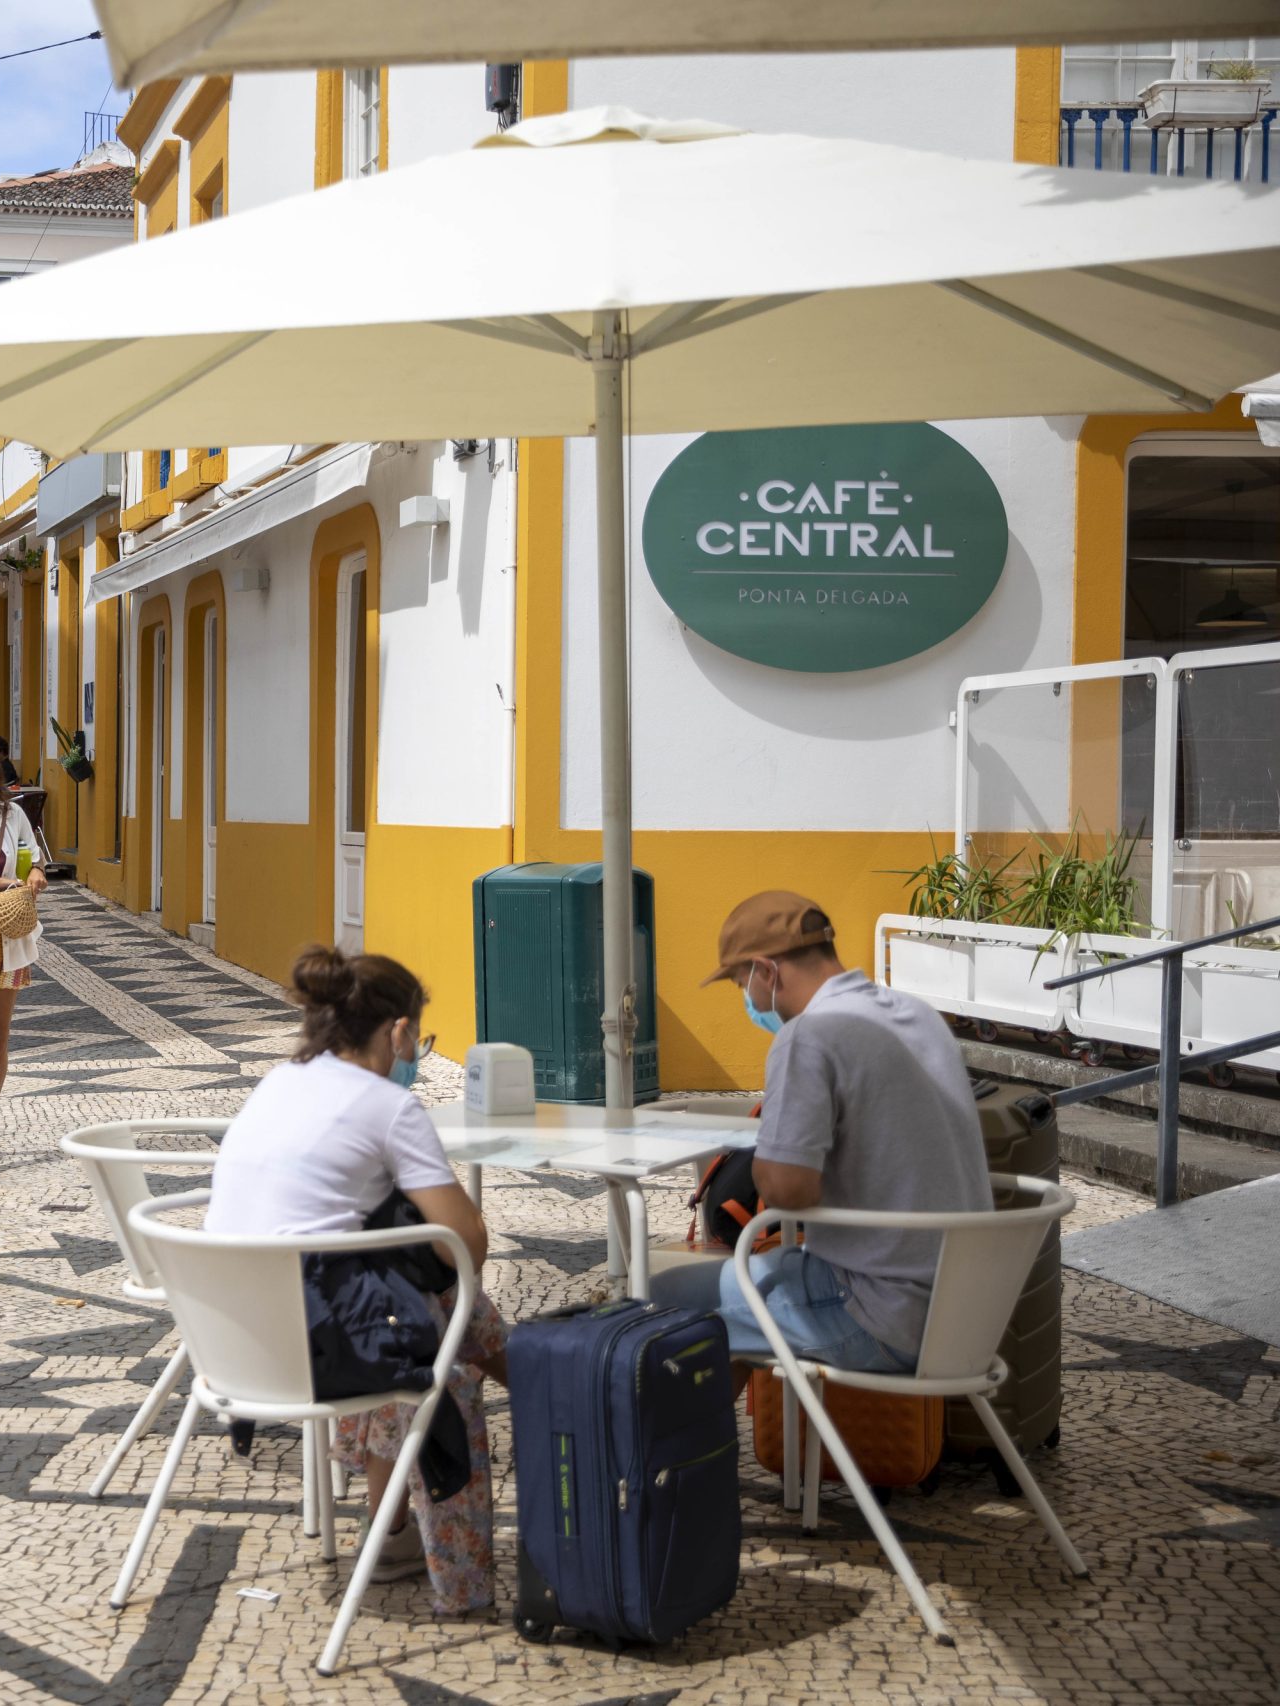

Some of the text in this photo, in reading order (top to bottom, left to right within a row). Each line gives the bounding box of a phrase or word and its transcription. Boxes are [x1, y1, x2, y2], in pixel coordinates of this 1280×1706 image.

[695, 520, 955, 558] CENTRAL
[738, 588, 910, 605] PONTA DELGADA
